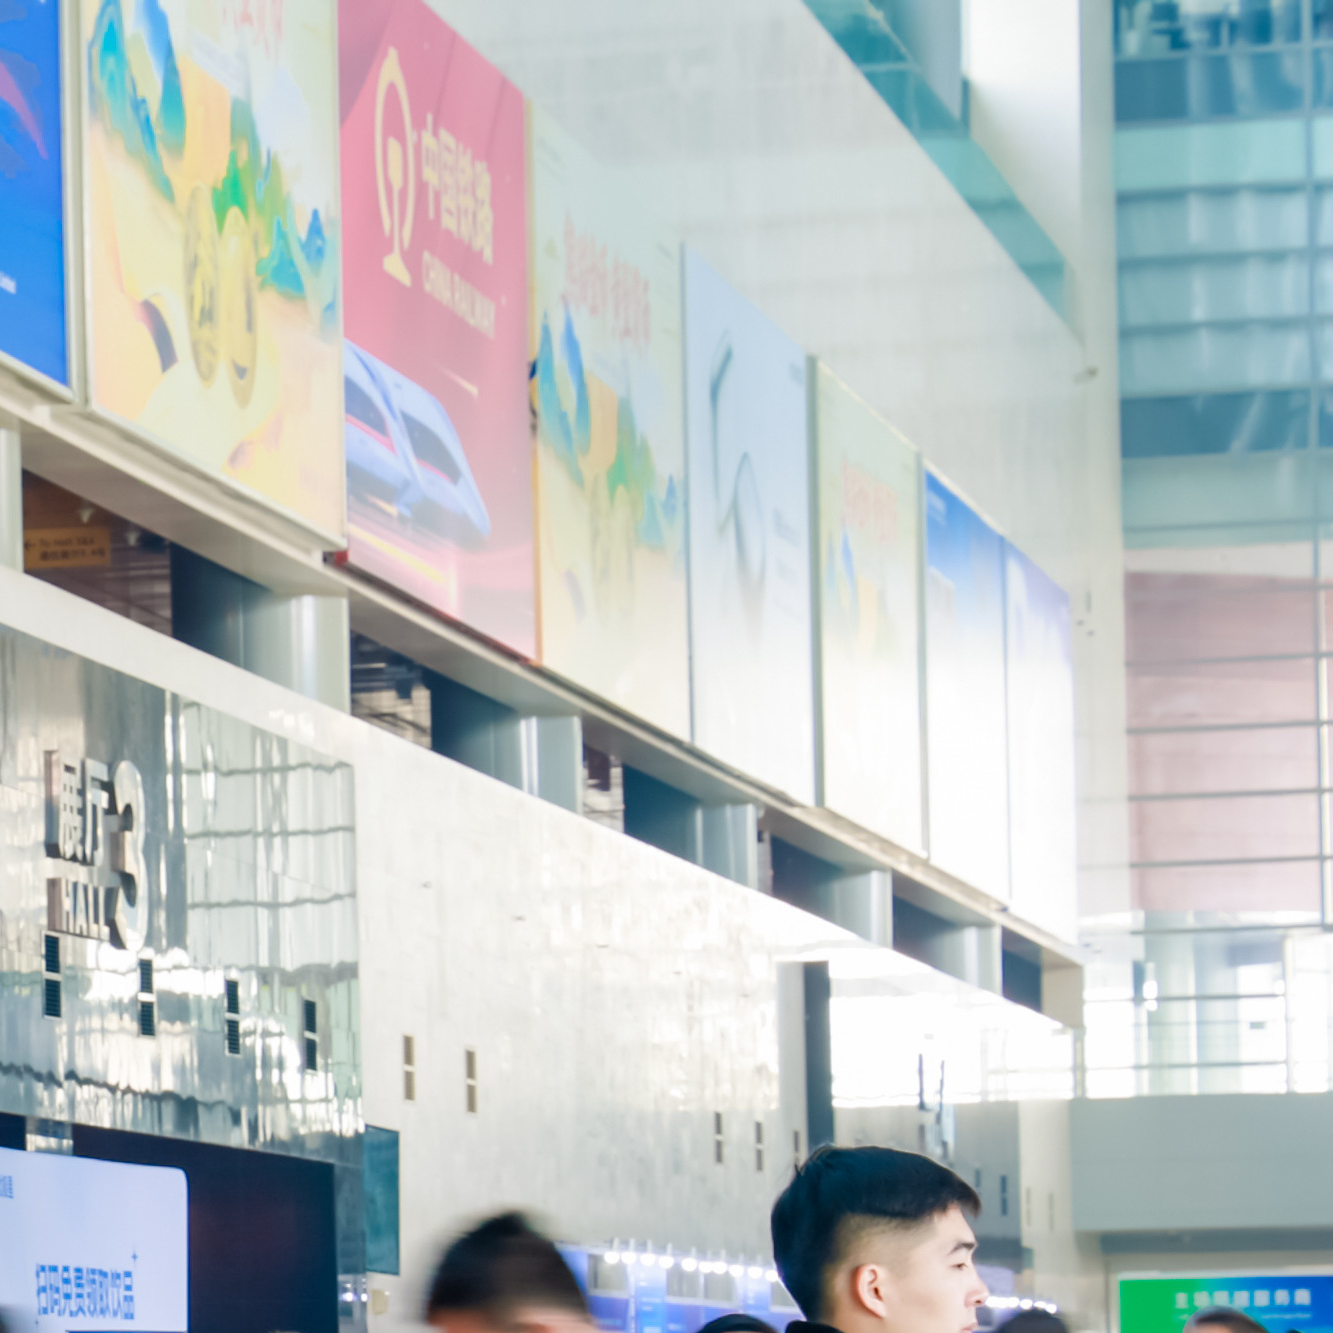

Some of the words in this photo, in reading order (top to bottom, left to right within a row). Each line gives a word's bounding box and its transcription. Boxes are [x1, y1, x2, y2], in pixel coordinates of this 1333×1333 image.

[59, 752, 109, 867] 展厅
[114, 760, 149, 950] 3
[59, 876, 110, 940] HALL
